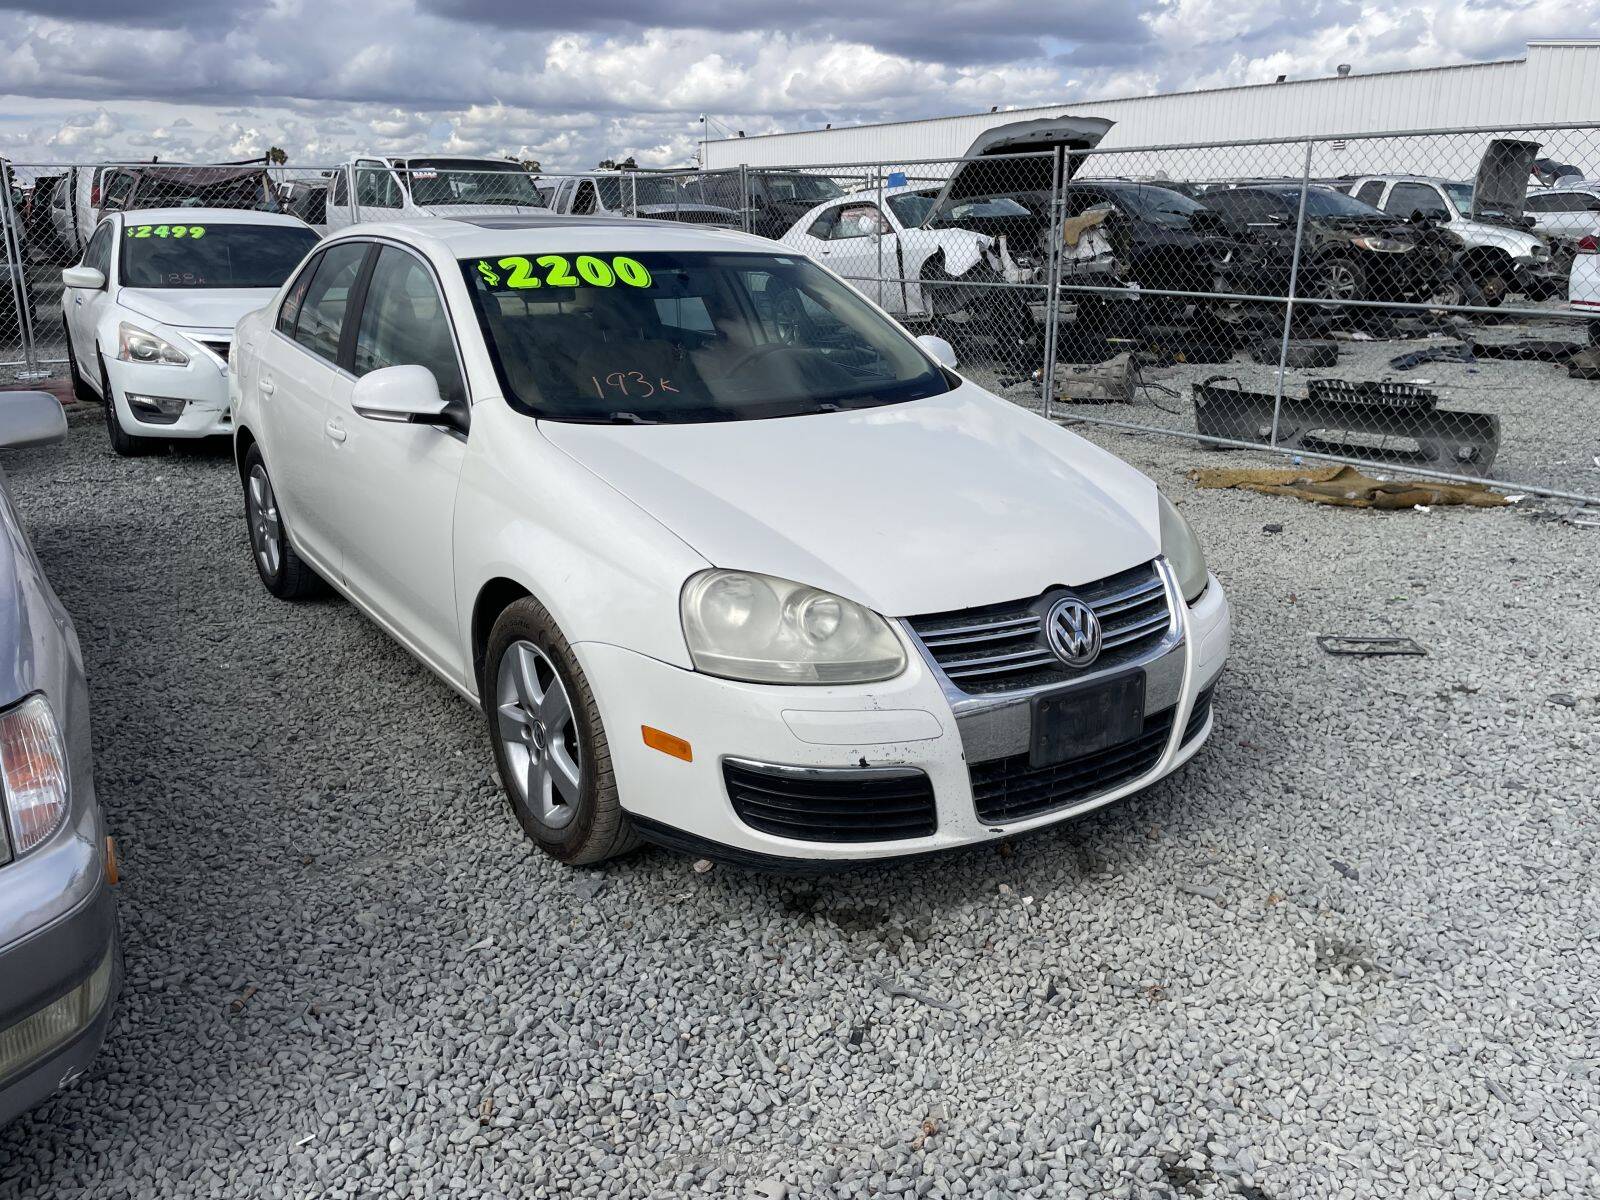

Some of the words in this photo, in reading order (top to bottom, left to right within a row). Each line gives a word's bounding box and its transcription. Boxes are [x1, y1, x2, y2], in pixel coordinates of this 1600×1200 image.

[127, 225, 206, 240] $2499
[477, 255, 652, 289] $2200
[1049, 600, 1101, 664] VW
